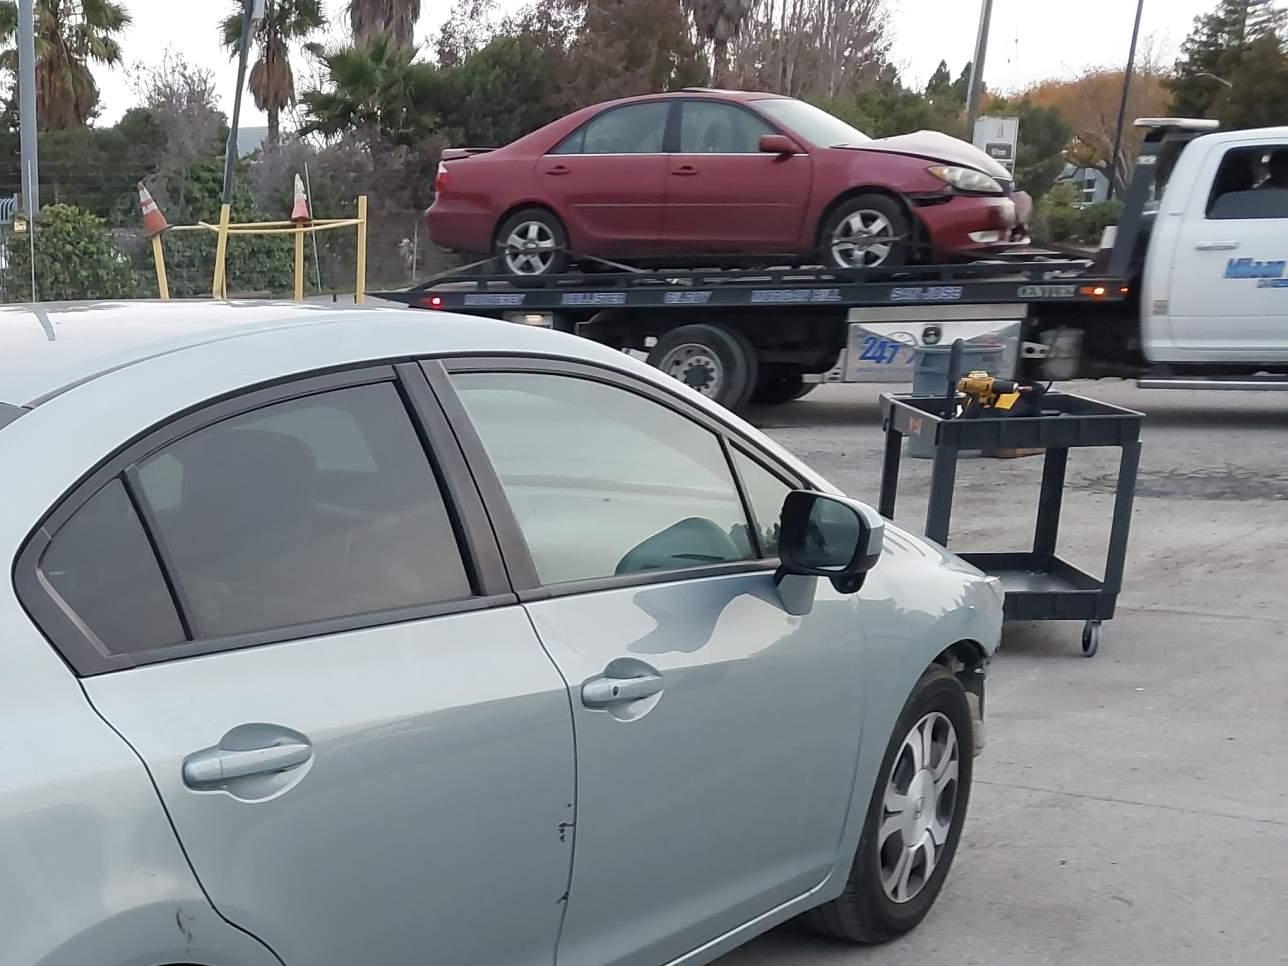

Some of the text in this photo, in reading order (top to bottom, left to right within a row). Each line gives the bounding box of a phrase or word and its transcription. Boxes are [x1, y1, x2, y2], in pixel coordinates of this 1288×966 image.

[810, 289, 842, 302] HILL
[891, 286, 963, 301] SAN JOSE
